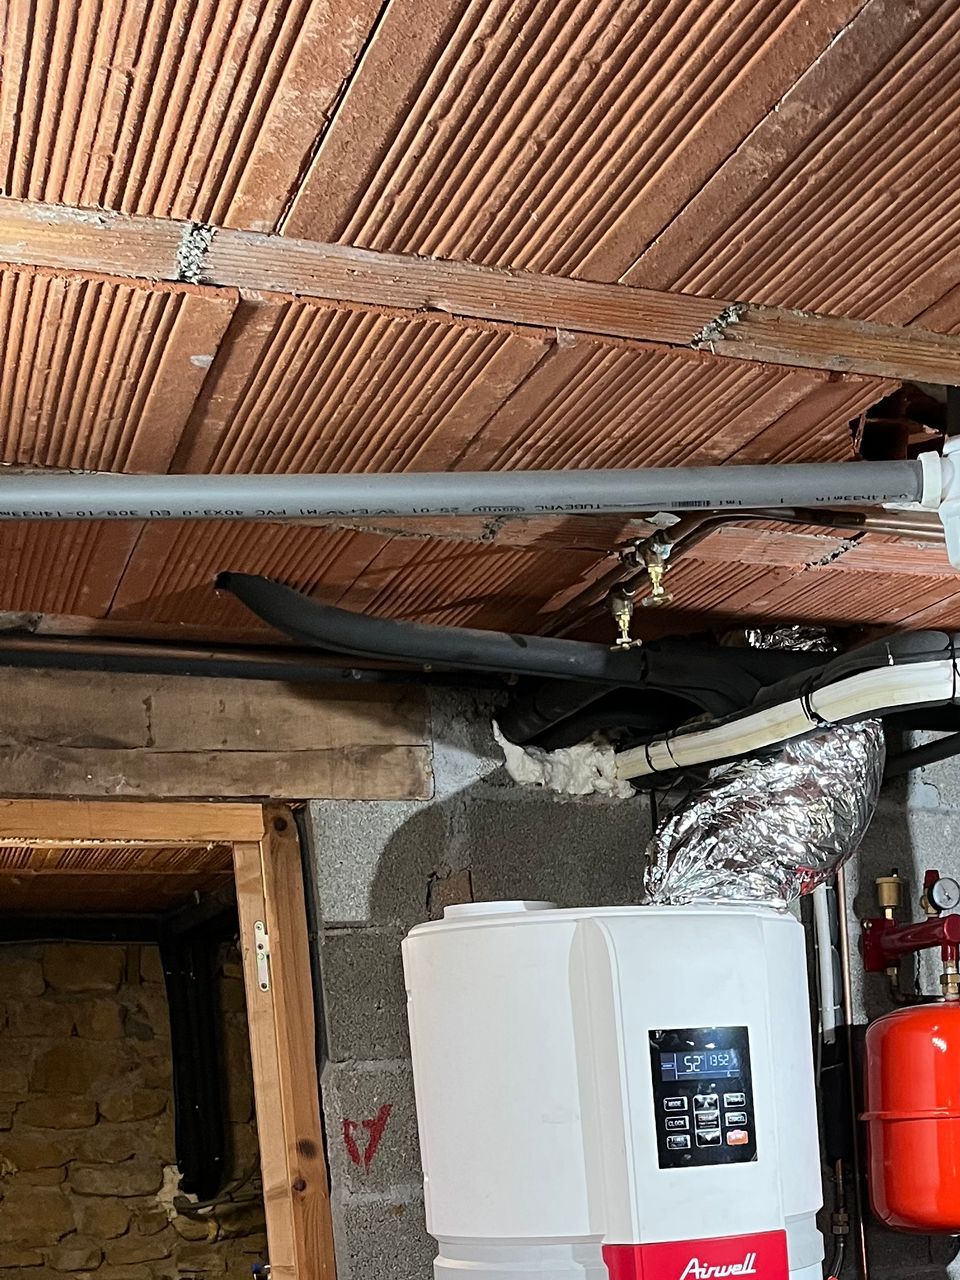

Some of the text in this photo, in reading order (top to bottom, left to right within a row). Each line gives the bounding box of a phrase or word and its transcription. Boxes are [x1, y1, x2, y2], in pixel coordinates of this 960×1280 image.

[256, 509, 287, 517] PVC
[668, 1119, 685, 1127] CLOCK
[680, 1251, 757, 1280] Airwell
